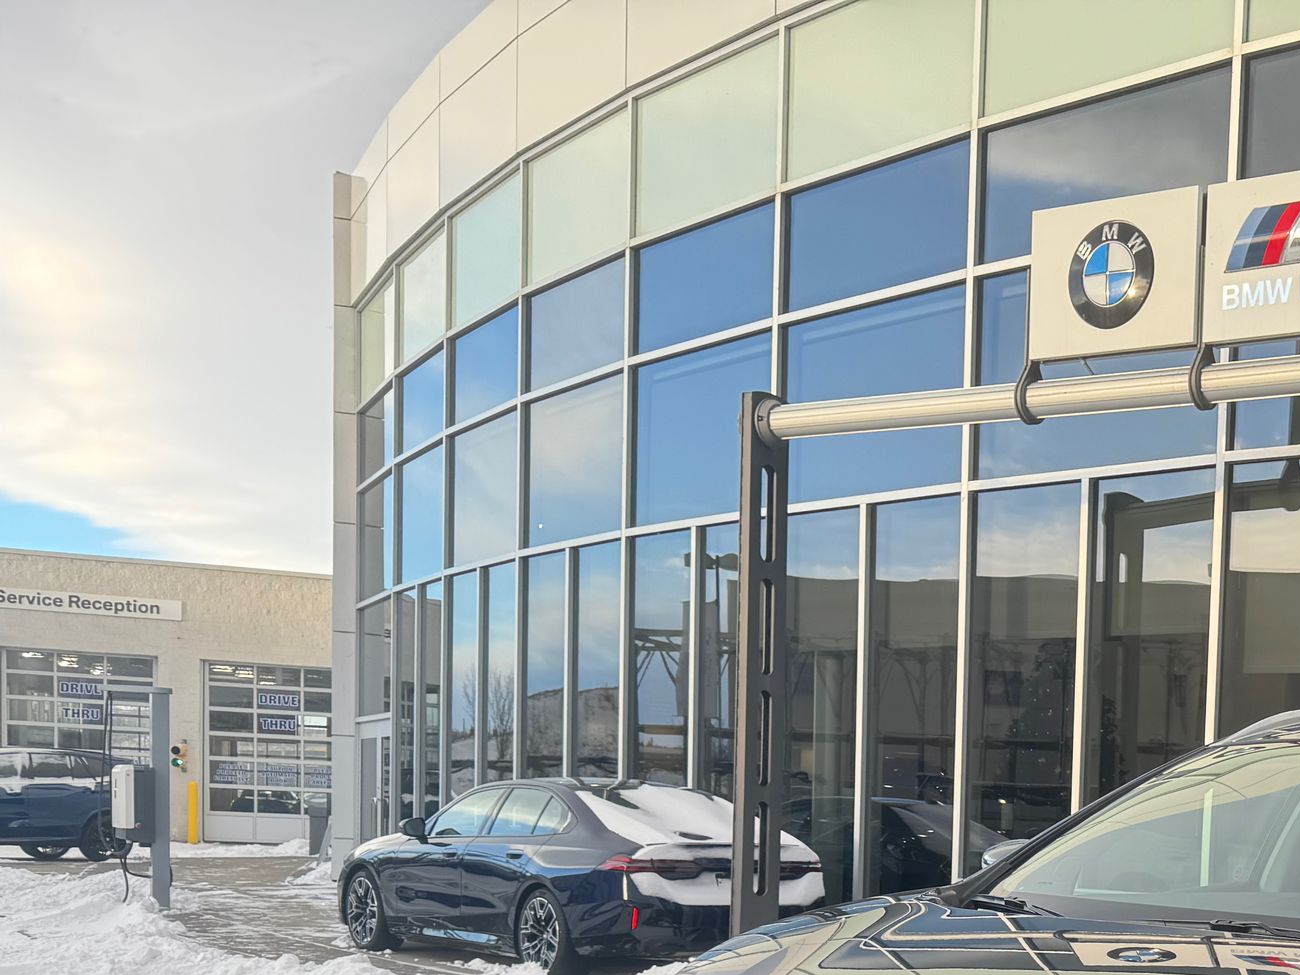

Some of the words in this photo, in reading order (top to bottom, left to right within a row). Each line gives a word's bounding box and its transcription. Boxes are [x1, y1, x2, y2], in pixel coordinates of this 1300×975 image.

[1077, 223, 1147, 261] BMW
[1221, 277, 1292, 311] BMW
[0, 589, 63, 607] Service
[68, 594, 160, 615] Reception
[258, 693, 298, 707] DRIVE
[63, 707, 100, 720] THRU
[260, 717, 296, 731] THRU
